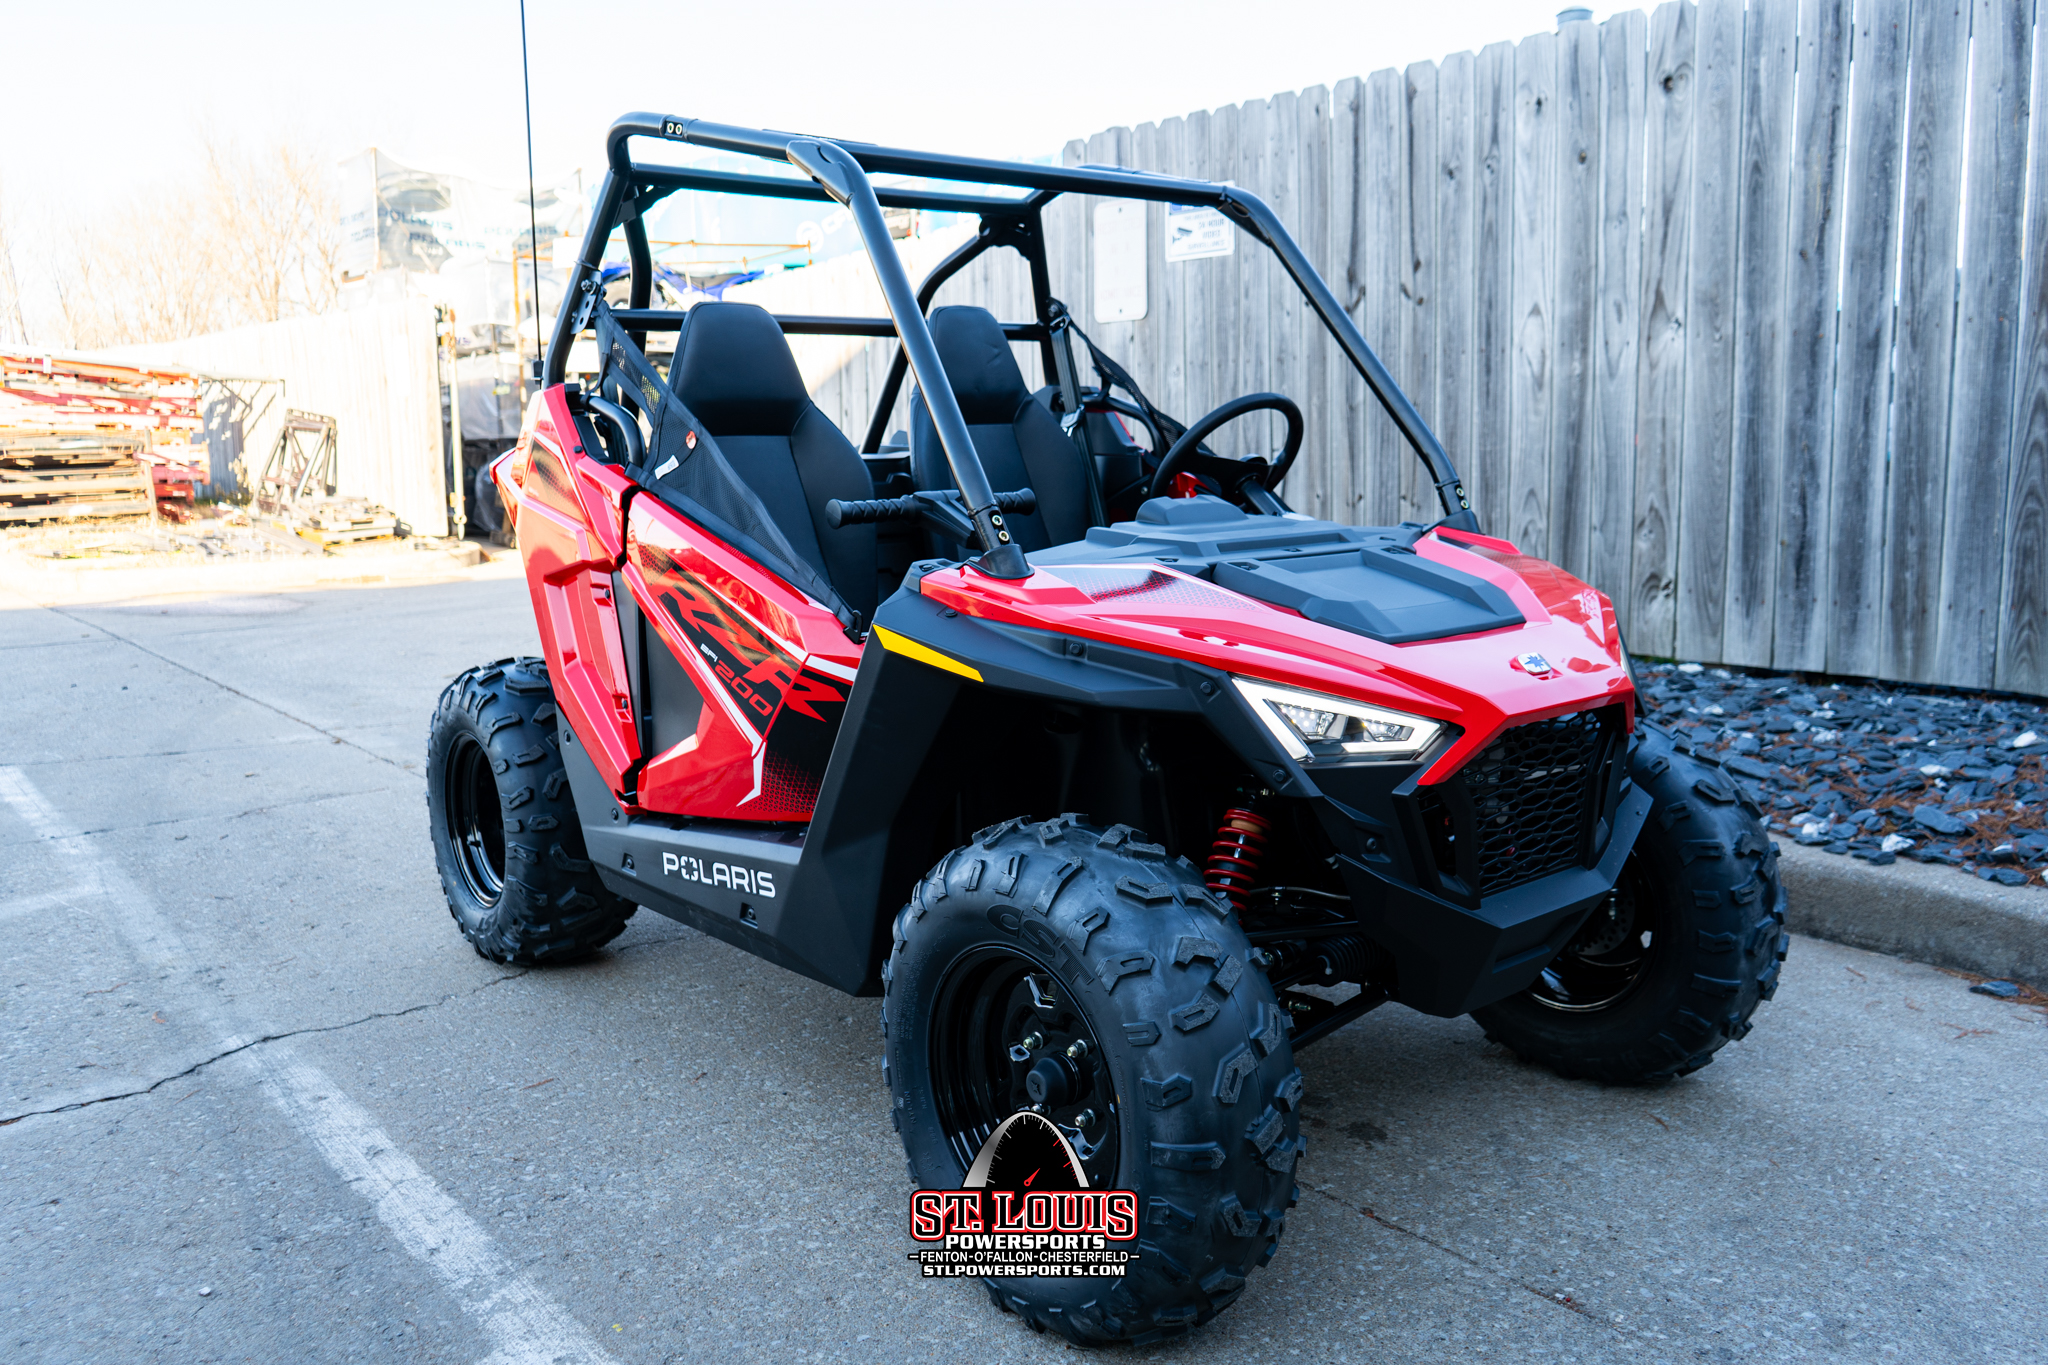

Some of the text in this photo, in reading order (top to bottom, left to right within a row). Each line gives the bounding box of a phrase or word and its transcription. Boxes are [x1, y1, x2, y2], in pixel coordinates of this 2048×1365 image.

[656, 570, 847, 723] RZR
[700, 643, 774, 716] EFI 200
[662, 851, 776, 898] POLARIS
[986, 904, 1095, 985] CST
